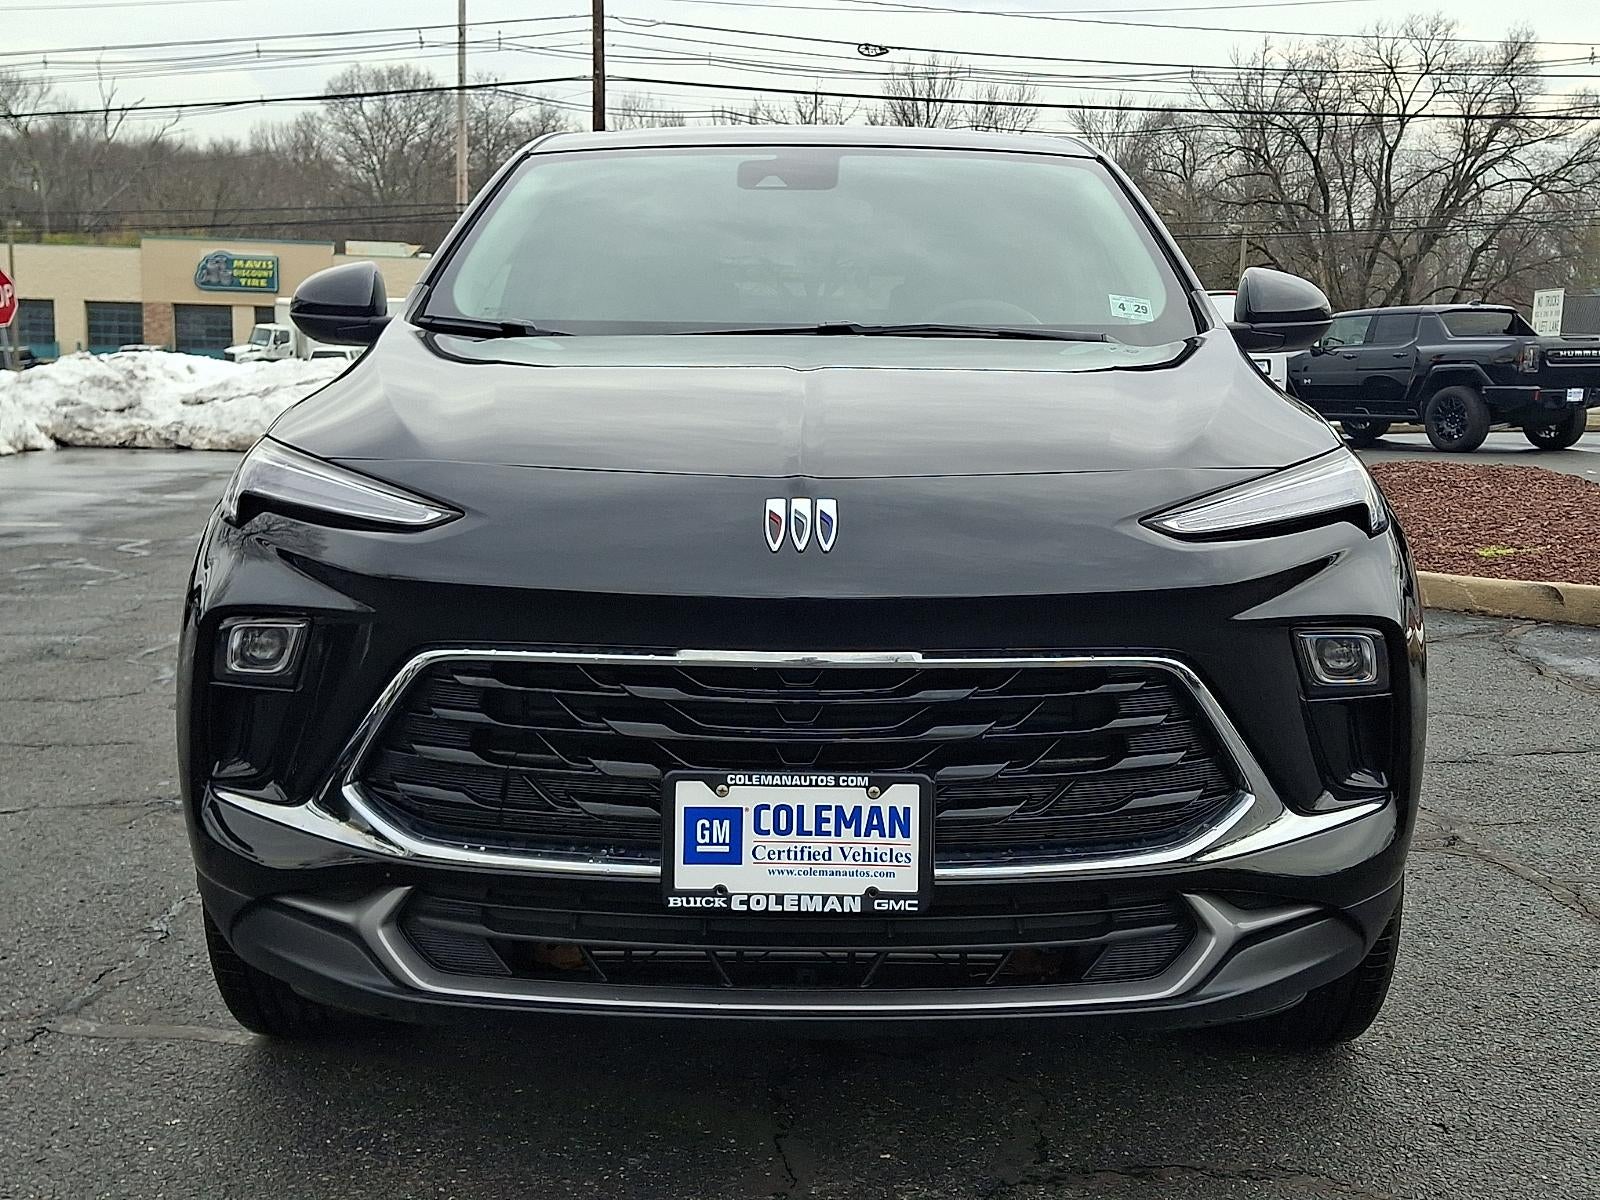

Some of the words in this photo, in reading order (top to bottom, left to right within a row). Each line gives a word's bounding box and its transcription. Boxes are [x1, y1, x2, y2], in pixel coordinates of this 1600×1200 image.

[233, 259, 273, 269] MAVIS
[233, 268, 273, 278] DISCOUNT
[239, 277, 268, 287] TIRE
[1118, 302, 1126, 311] 4
[1134, 304, 1148, 314] 29
[726, 774, 835, 786] COLEMANAUTOS
[839, 776, 869, 787] COM
[753, 803, 911, 839] COLEMAN
[696, 818, 730, 844] GM
[751, 844, 832, 862] Certified
[839, 846, 912, 864] Vehicles
[767, 867, 896, 879] www.colemanautos.com
[667, 896, 728, 908] BUICK
[730, 894, 861, 913] COLEMAN
[873, 899, 919, 911] GMC
